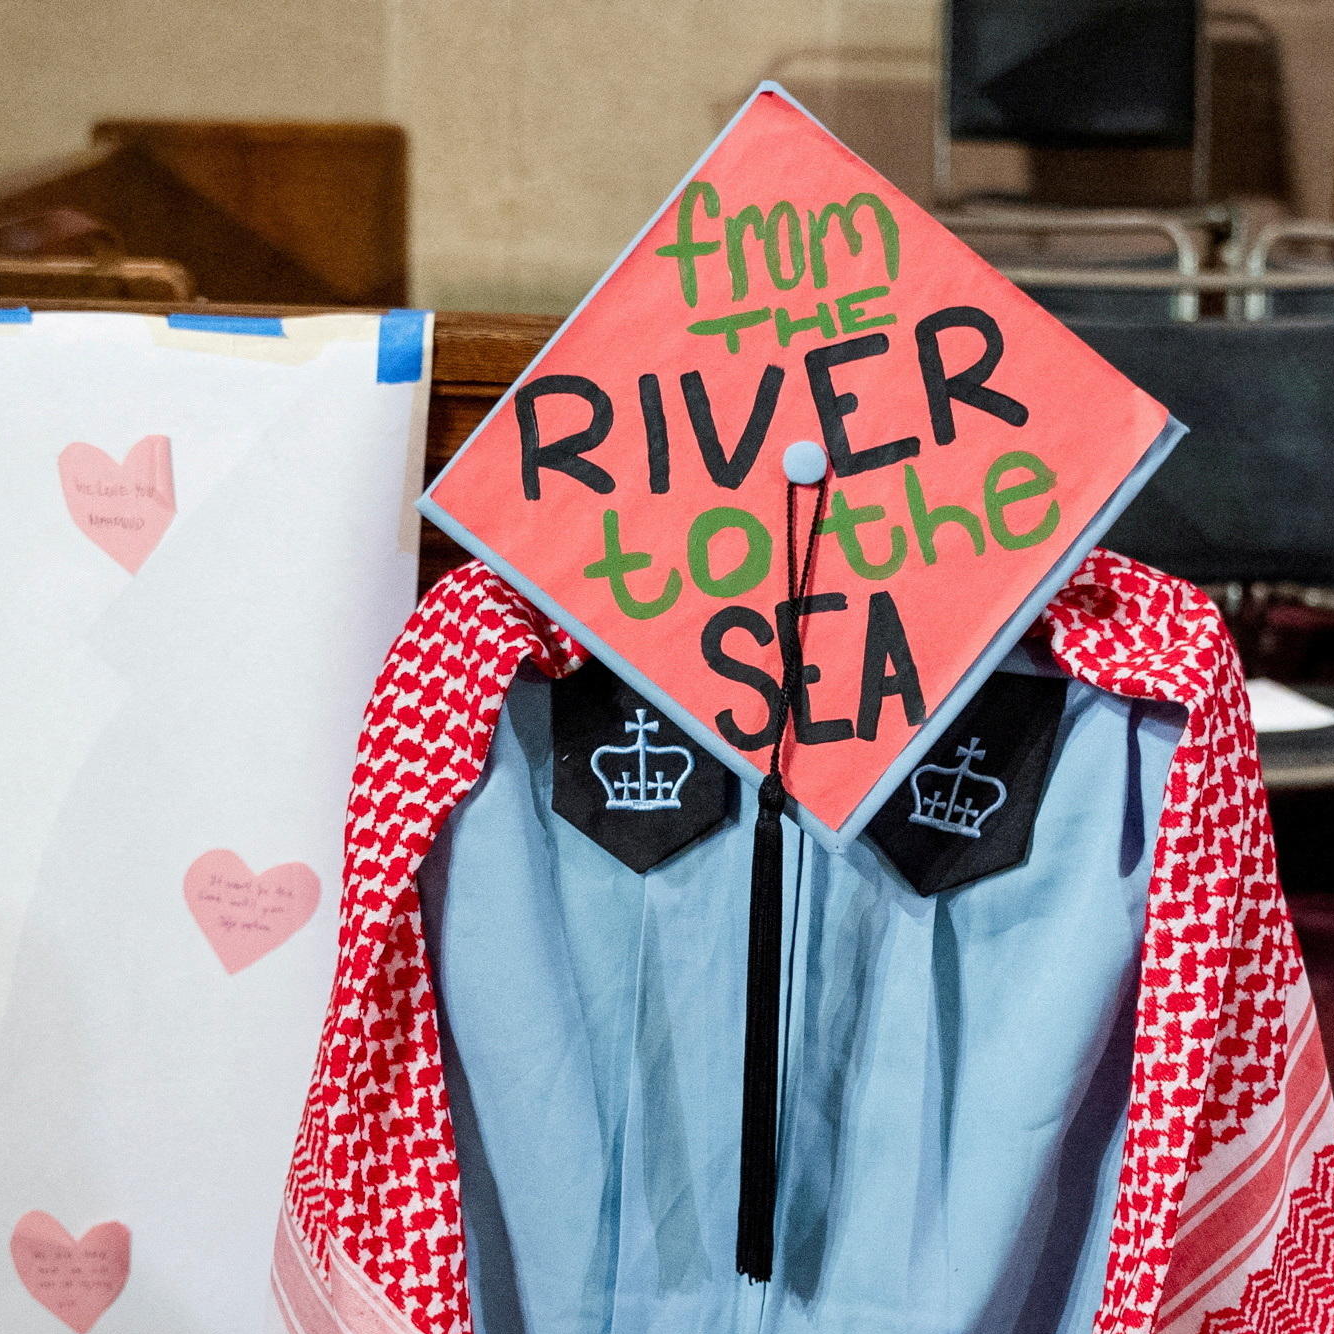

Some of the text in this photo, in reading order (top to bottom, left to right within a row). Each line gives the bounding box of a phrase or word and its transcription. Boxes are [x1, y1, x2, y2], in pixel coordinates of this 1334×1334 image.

[655, 181, 902, 309] from
[686, 285, 898, 354] THE
[513, 305, 1029, 501] RIVER
[583, 451, 1060, 620] to the
[700, 590, 926, 751] SEA
